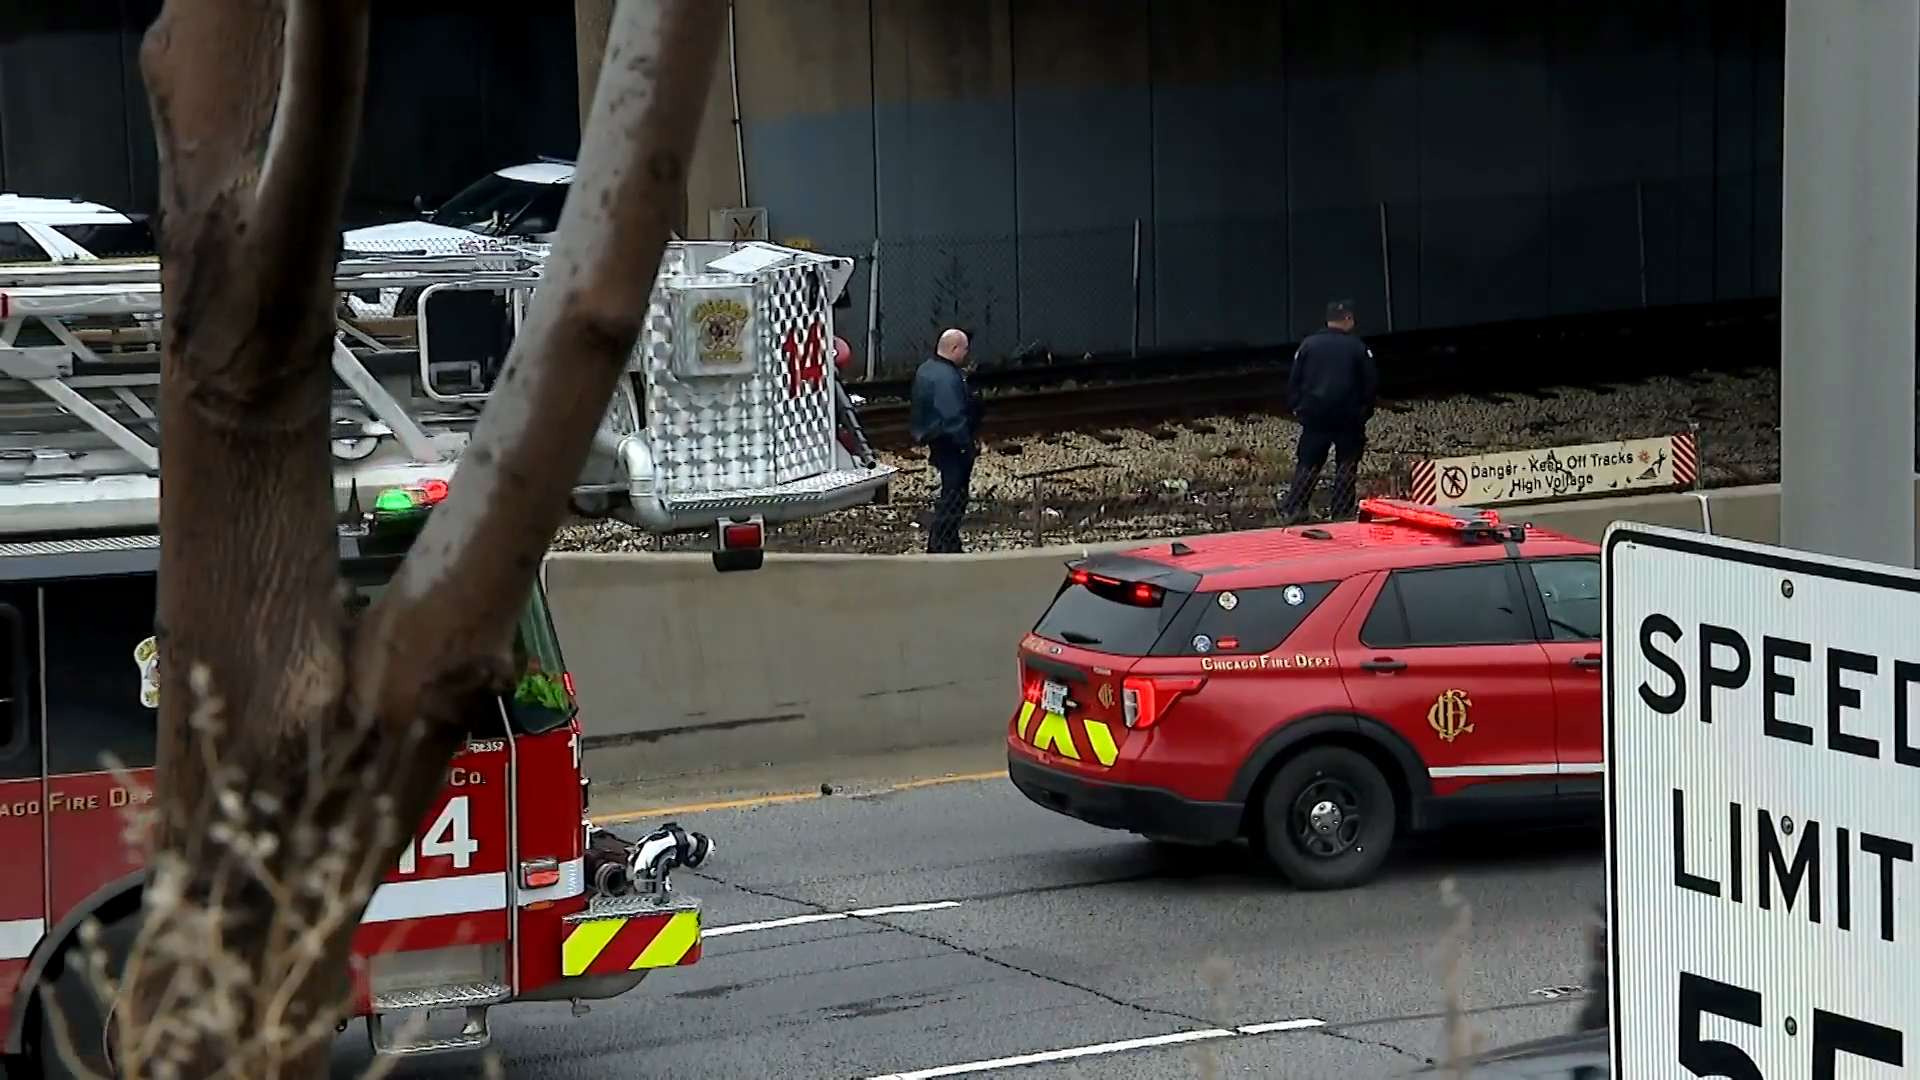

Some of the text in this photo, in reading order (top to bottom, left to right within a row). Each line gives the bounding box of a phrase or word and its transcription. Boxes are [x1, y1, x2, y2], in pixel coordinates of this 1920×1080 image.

[782, 322, 823, 399] 14
[1471, 463, 1518, 480] Danger
[1530, 458, 1563, 474] Keep
[1567, 455, 1586, 470] Off
[1590, 451, 1633, 467] Tracks
[1512, 474, 1594, 494] High Voltage
[50, 791, 99, 812] FIRE
[1673, 788, 1913, 941] LIMIT
